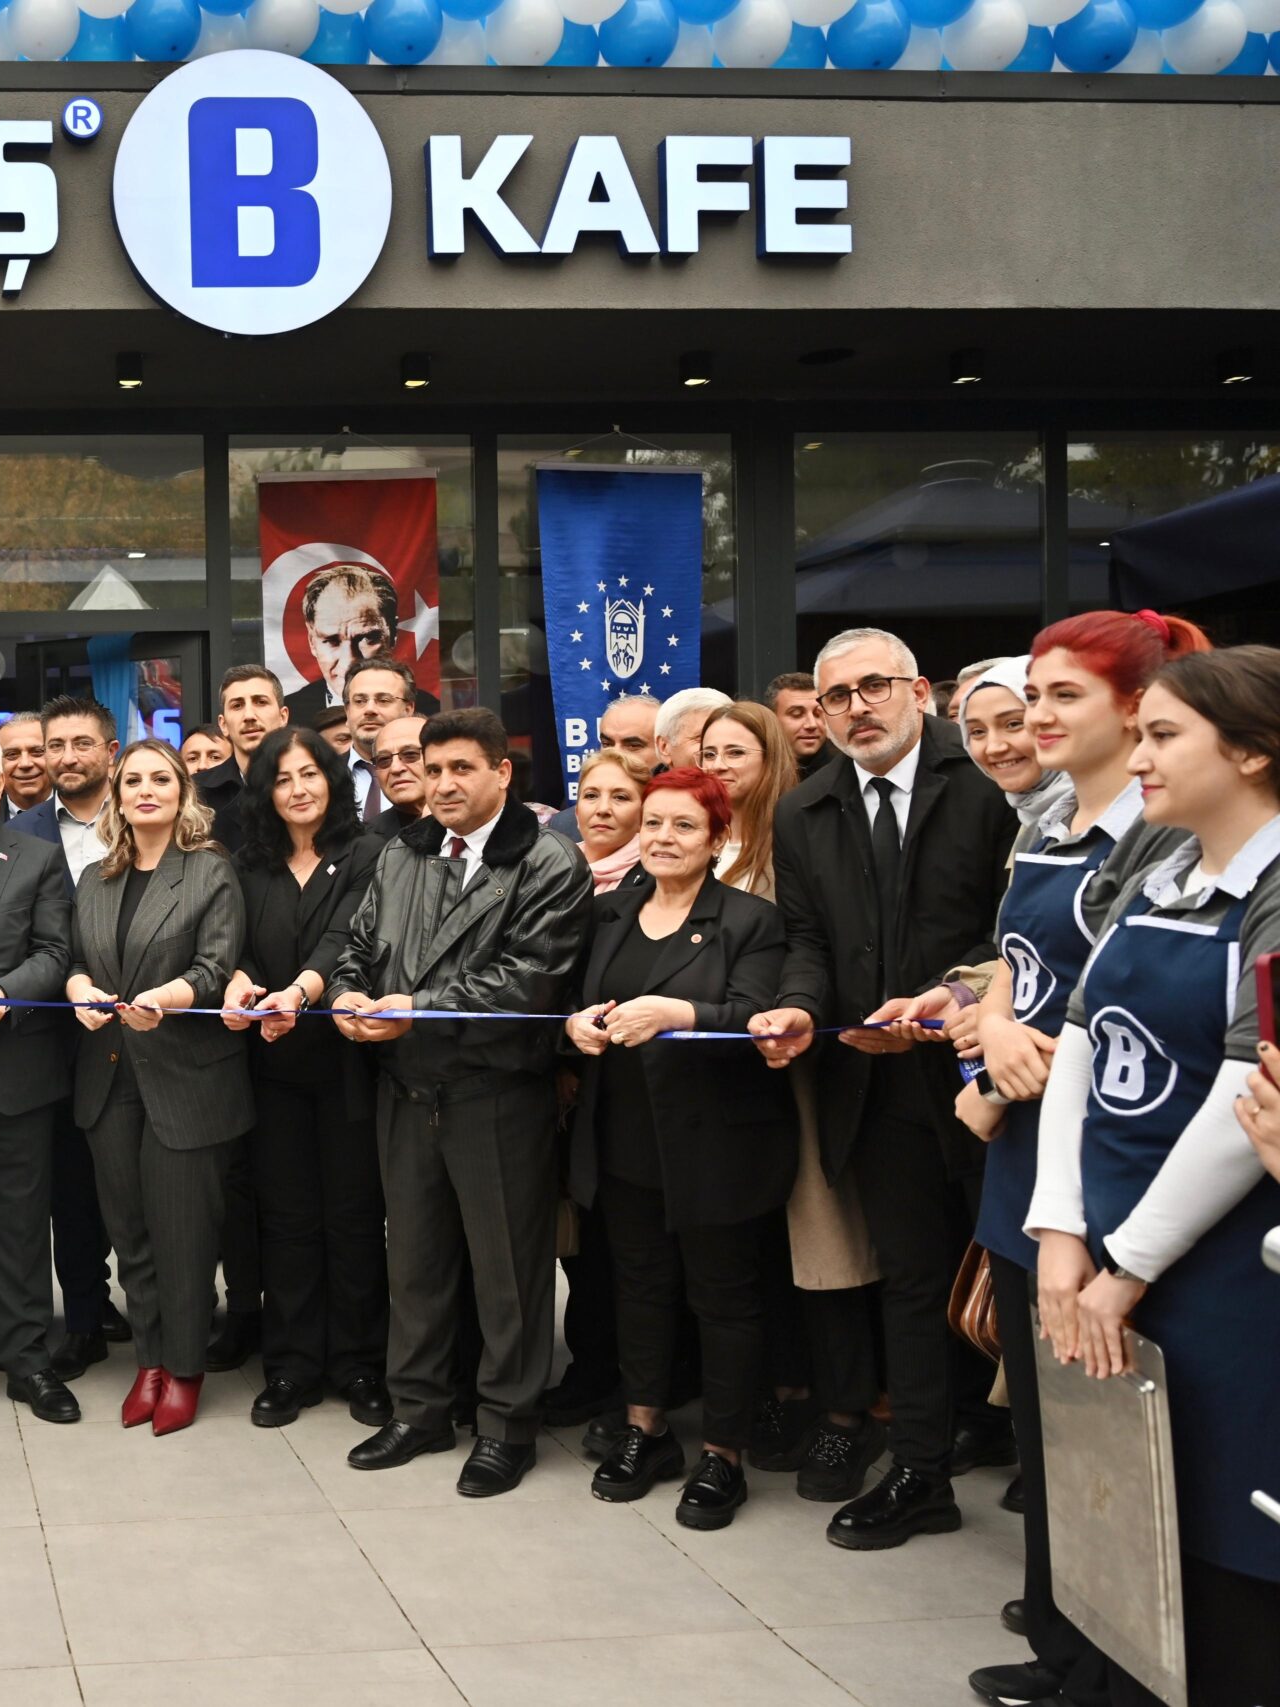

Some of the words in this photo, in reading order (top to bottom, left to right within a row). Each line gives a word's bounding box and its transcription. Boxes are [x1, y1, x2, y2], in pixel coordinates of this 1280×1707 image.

[188, 96, 321, 288] B
[425, 134, 852, 256] KAFE
[1007, 946, 1040, 1011] B
[1100, 1020, 1147, 1100] B
